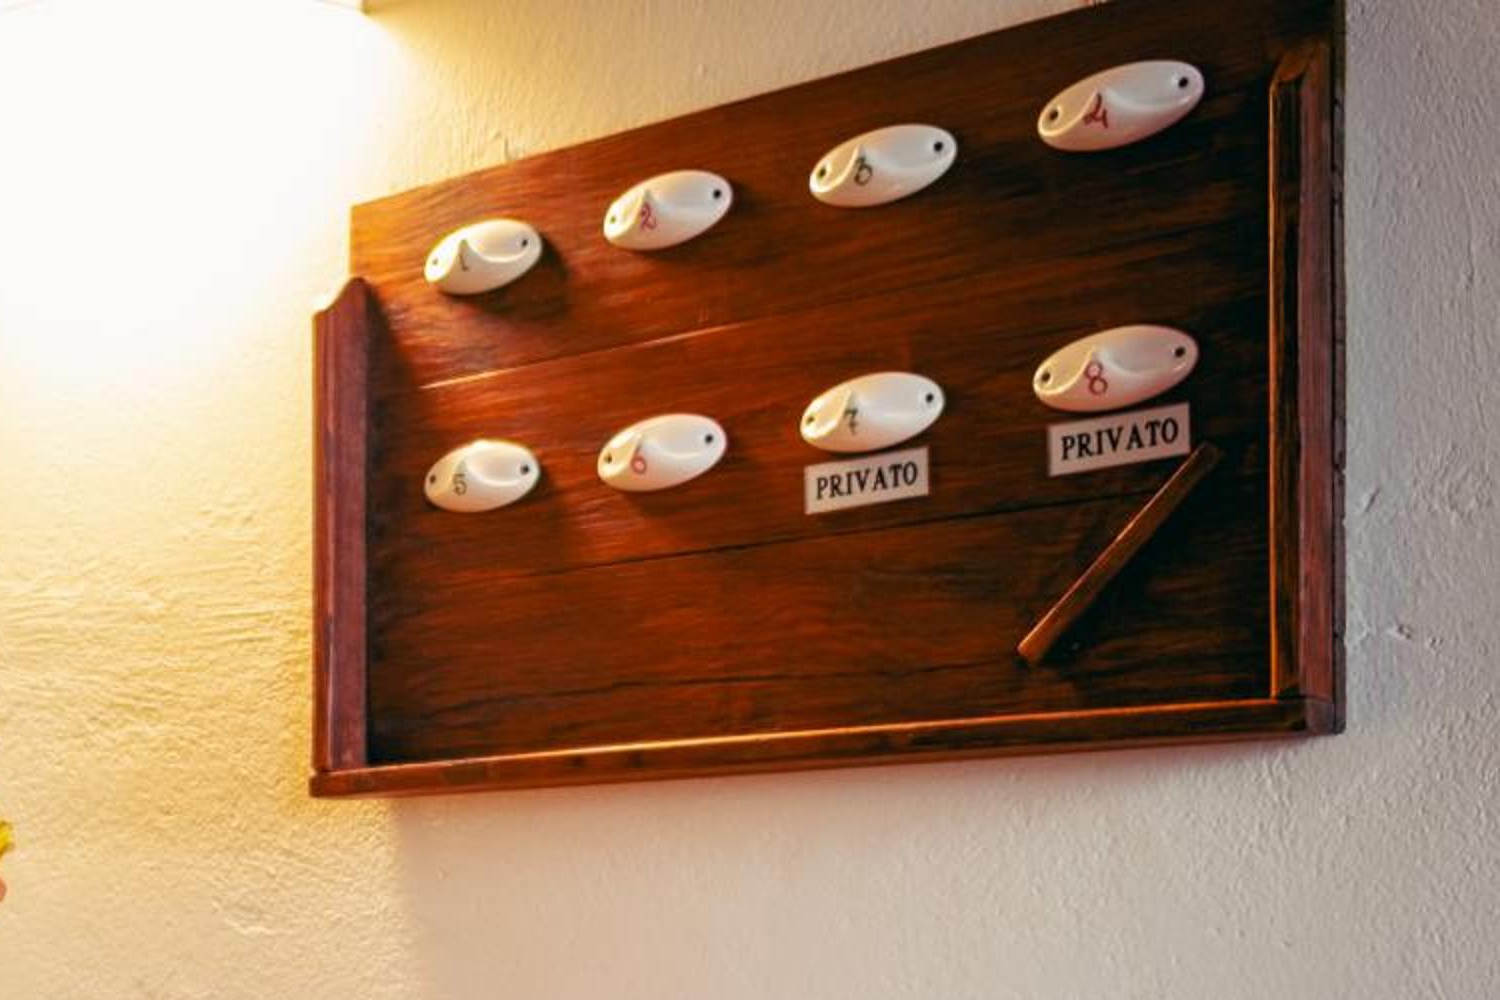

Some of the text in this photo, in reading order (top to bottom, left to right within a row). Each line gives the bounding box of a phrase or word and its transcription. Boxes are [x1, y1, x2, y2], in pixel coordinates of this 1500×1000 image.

[1085, 361, 1108, 396] 8
[843, 407, 859, 436] 7
[1060, 416, 1180, 461] PRIVATO
[451, 472, 468, 497] 5
[815, 460, 919, 500] PRIVATO
